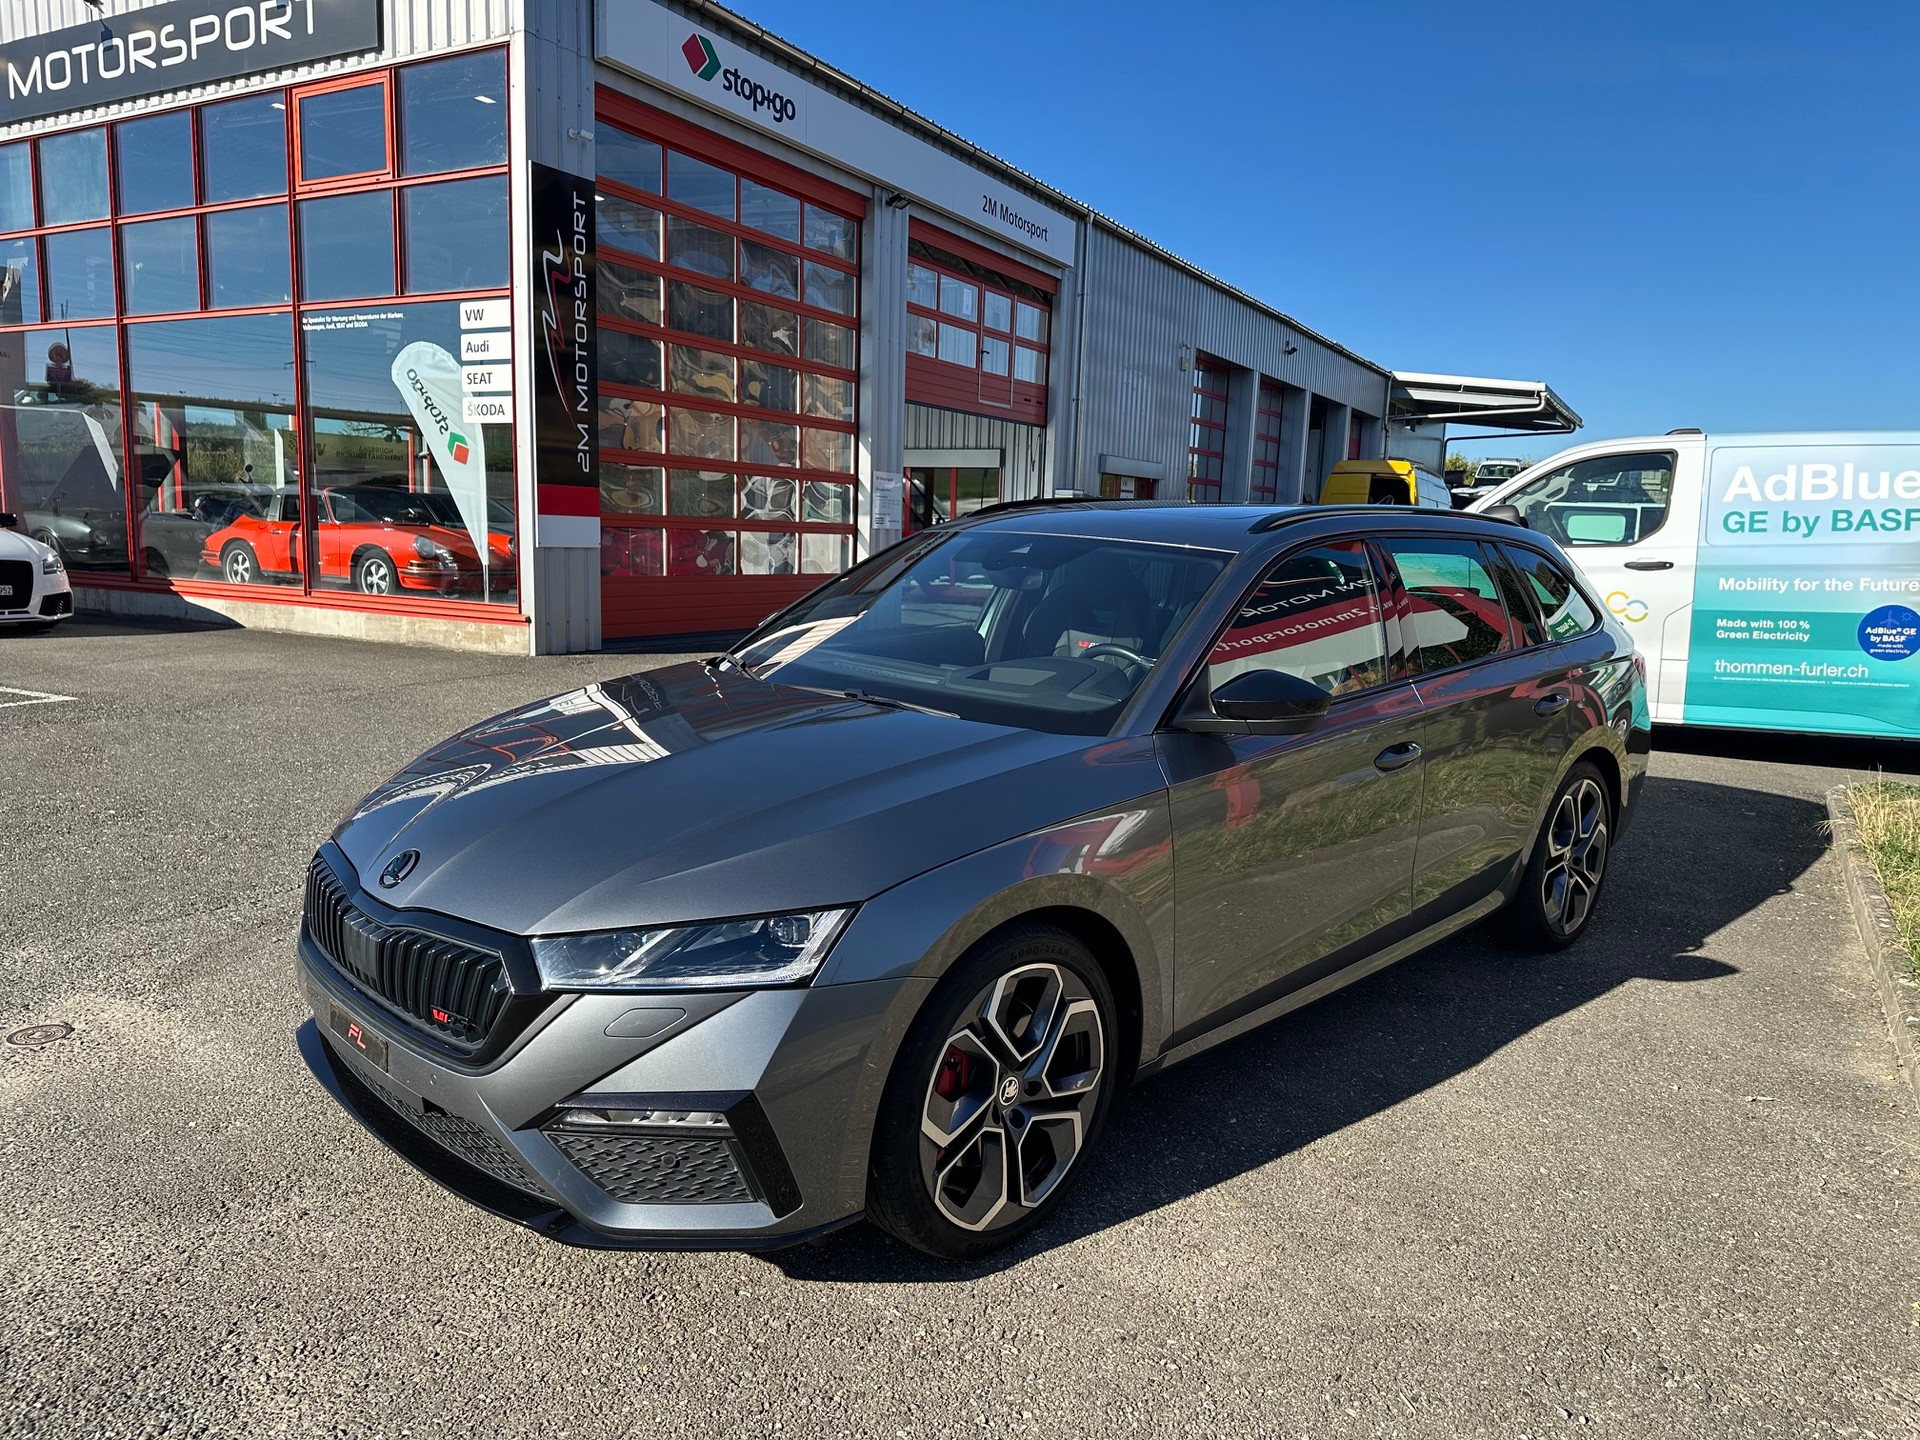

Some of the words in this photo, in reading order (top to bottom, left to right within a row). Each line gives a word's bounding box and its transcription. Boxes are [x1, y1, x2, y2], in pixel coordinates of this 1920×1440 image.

[7, 0, 315, 100] MOTORSPORT
[722, 68, 796, 123] stop+go
[982, 194, 997, 218] 2M
[1000, 203, 1048, 242] Motorsport
[573, 190, 590, 413] MOTORSPORT
[465, 308, 484, 322] VW
[466, 339, 490, 354] Audi
[467, 372, 493, 385] SEAT
[467, 401, 506, 417] ŠKODA
[577, 423, 590, 473] 2M
[1722, 463, 1920, 503] AdBlue
[1722, 511, 1769, 534] GE
[1782, 510, 1820, 539] by
[1831, 508, 1920, 532] BASF
[1718, 577, 1789, 594] Mobility
[1793, 577, 1820, 592] for
[1824, 577, 1854, 592] the
[1859, 578, 1920, 592] Future
[1716, 619, 1747, 628] Made
[1750, 619, 1774, 629] with
[1778, 620, 1797, 629] 100
[1799, 621, 1810, 630] %
[1902, 627, 1917, 635] GE
[1716, 630, 1750, 640] Green
[1752, 630, 1811, 643] Electricity
[1870, 634, 1881, 643] by
[1714, 659, 1870, 679] thommen-furler.ch
[347, 1022, 367, 1050] FL
